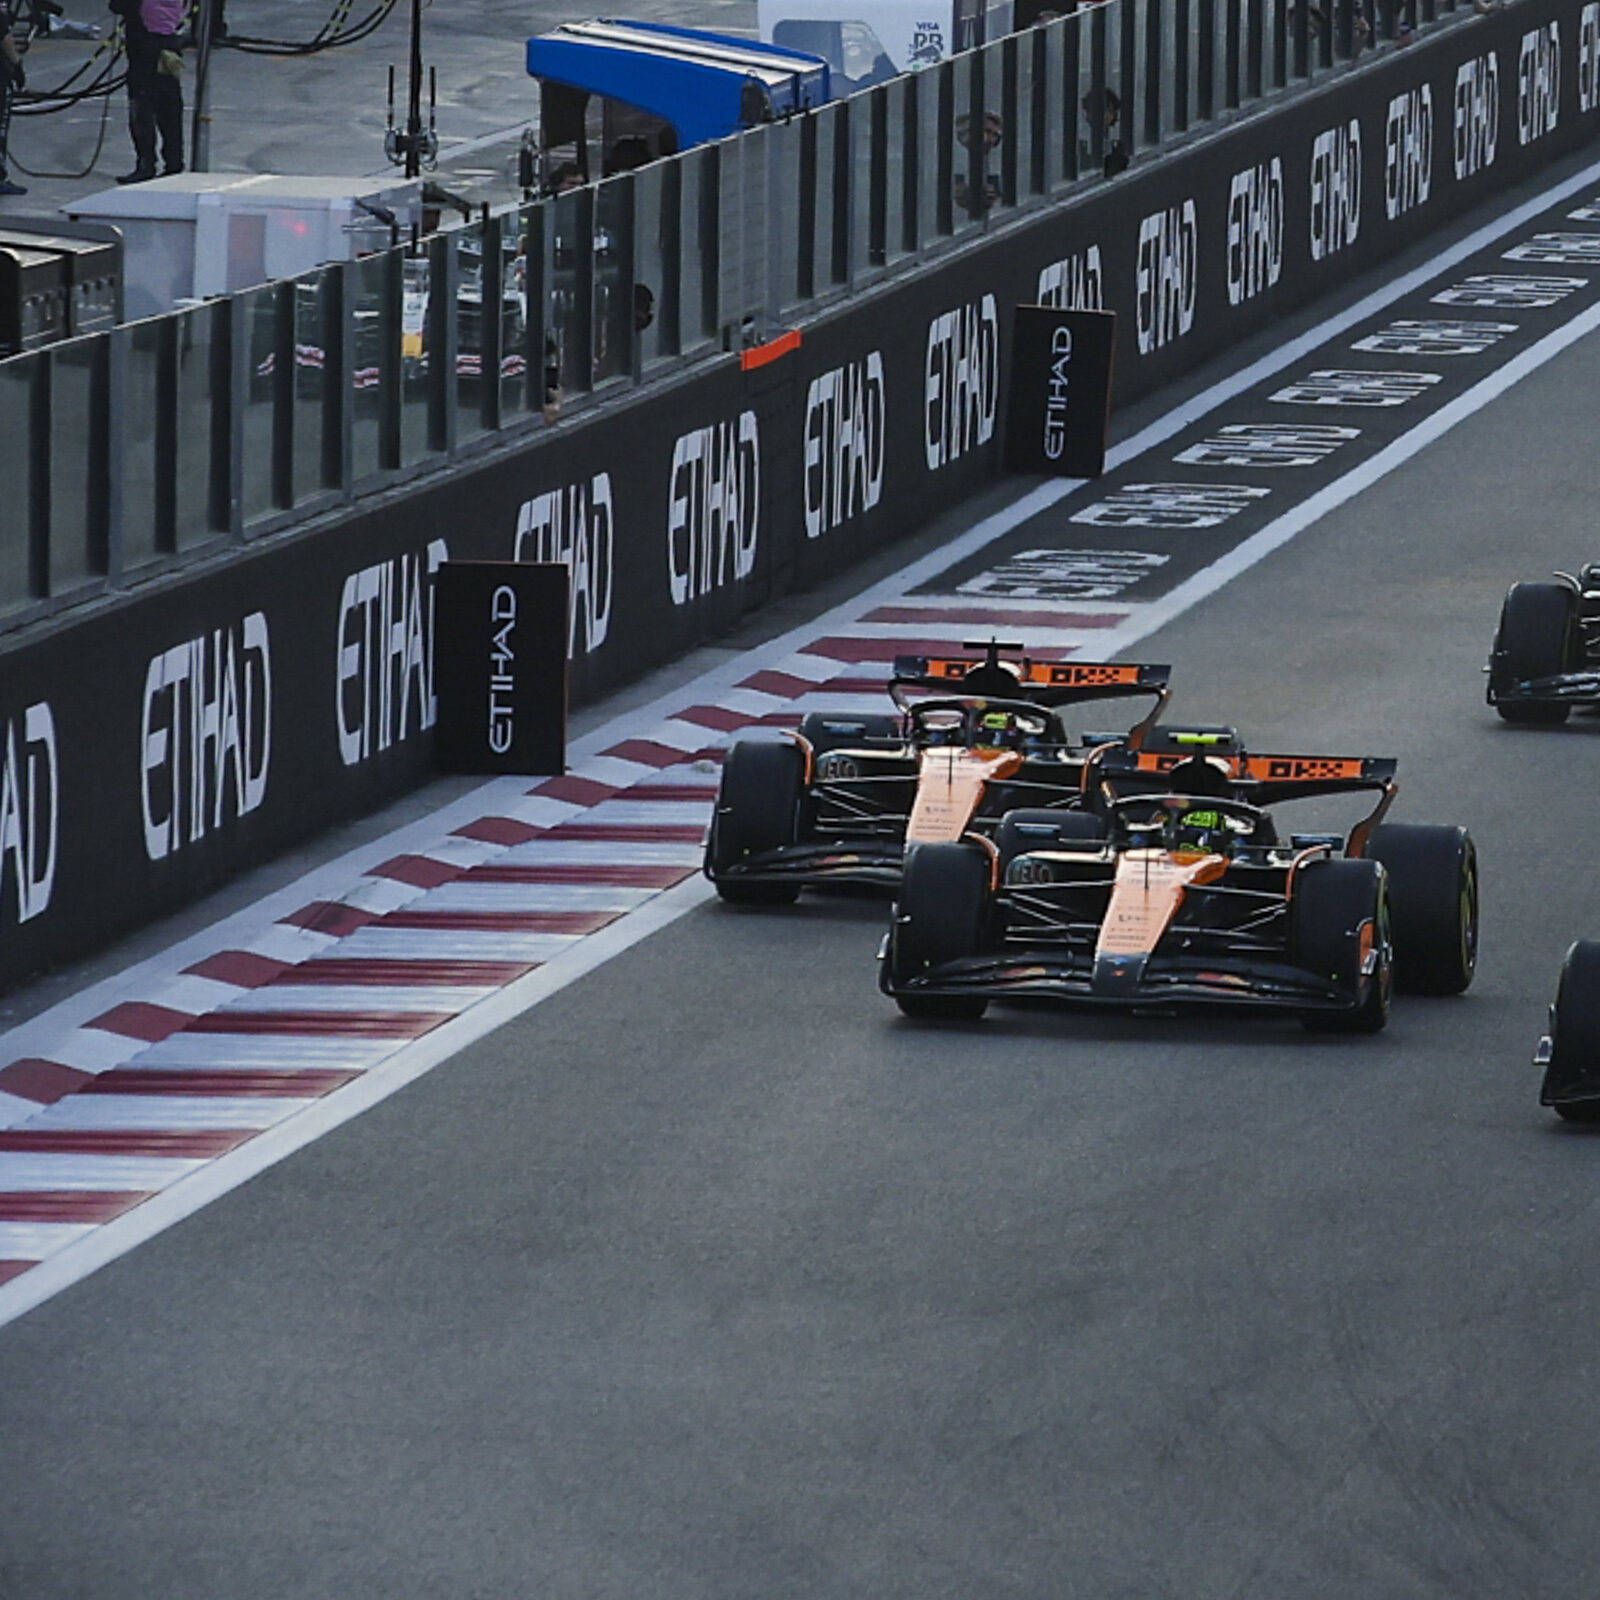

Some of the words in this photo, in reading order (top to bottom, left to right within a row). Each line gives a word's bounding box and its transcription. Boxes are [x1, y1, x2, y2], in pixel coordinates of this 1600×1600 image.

[1136, 200, 1198, 356] ETIHAD
[804, 352, 886, 539] ETIHAD
[924, 294, 999, 471] ETIHAD
[1045, 325, 1072, 460] ETIHAD
[668, 411, 760, 606] ETIHAD
[141, 612, 272, 861] ETIHAD
[488, 584, 517, 754] ETIHAD
[1052, 666, 1120, 685] OKX
[1269, 760, 1344, 779] OKX
